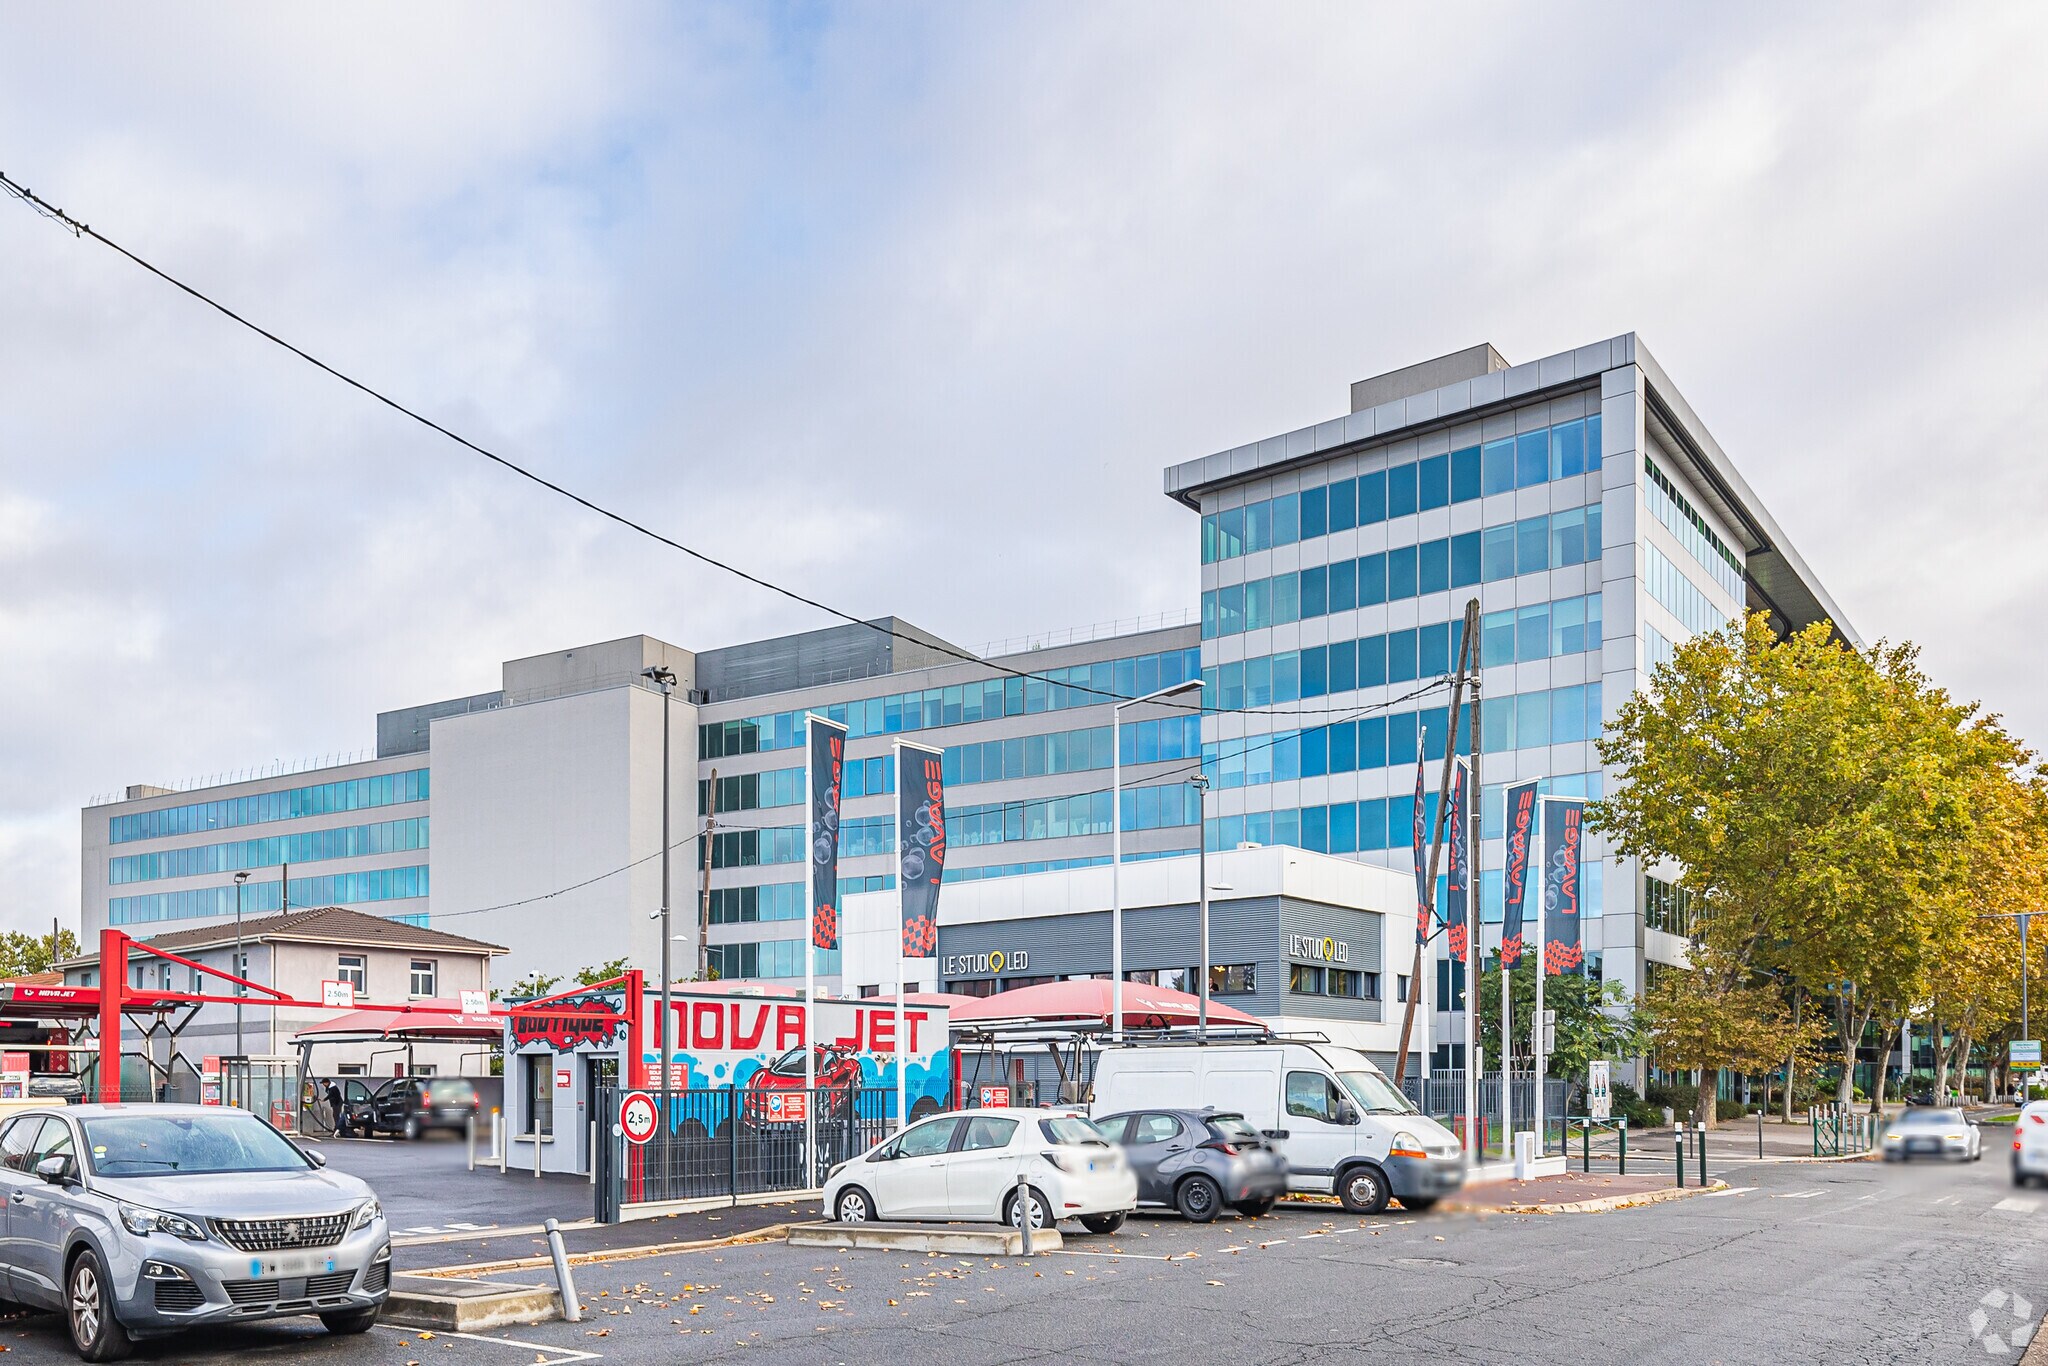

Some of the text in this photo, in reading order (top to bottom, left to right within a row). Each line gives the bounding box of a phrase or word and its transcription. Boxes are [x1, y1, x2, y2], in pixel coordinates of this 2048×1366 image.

[924, 759, 943, 885] AVAGE
[1509, 790, 1533, 905] LAVAGE
[1561, 809, 1581, 915] LAVAGE
[942, 956, 956, 975] LE
[1006, 951, 1028, 970] LED
[1289, 934, 1301, 956] LE
[1334, 940, 1348, 962] LED
[517, 1010, 605, 1036] BOUTIQUE
[653, 1000, 928, 1053] NOVA JET
